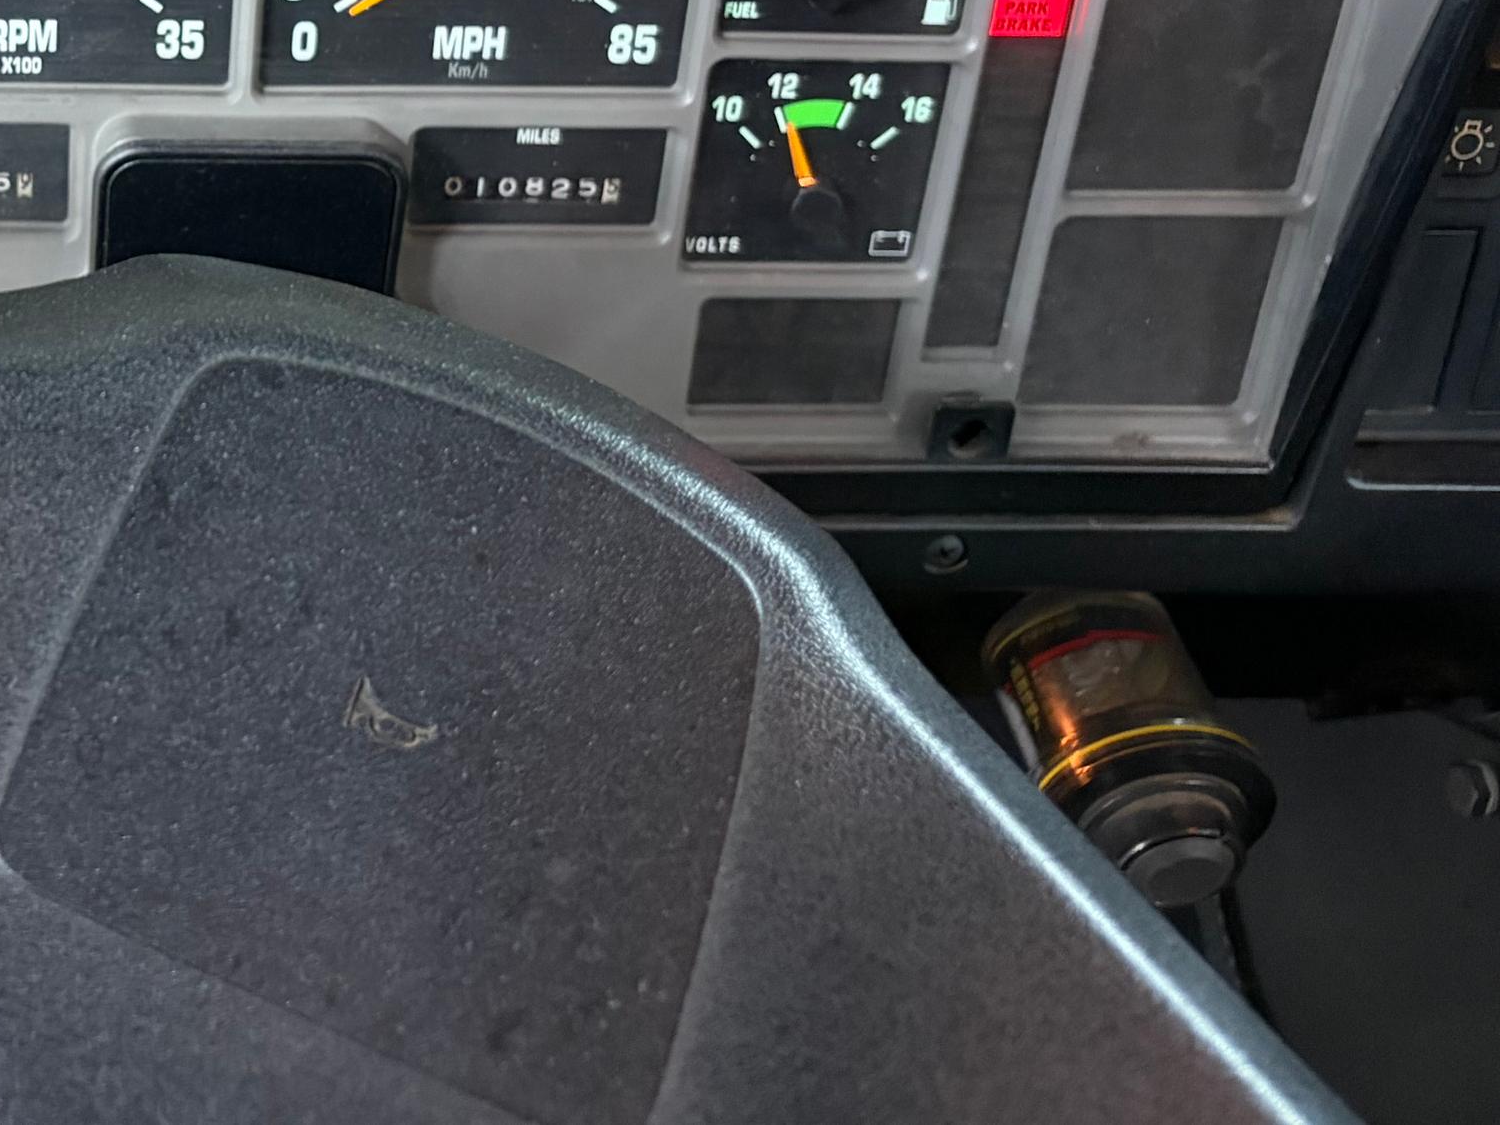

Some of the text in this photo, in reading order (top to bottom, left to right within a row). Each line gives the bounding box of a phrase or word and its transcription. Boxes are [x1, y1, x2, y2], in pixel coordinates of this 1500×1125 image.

[724, 1, 760, 19] FUEL
[1005, 1, 1049, 15] PARK
[155, 19, 204, 60] 35
[291, 20, 318, 61] 0
[432, 26, 507, 60] MPH
[607, 24, 659, 64] 85
[1, 57, 42, 74] X100
[448, 62, 488, 78] Km/h
[767, 72, 800, 99] 12
[850, 73, 882, 100] 14
[712, 95, 744, 122] 10
[901, 96, 935, 123] 16
[516, 128, 560, 145] MILES
[685, 236, 741, 254] VOLTS
